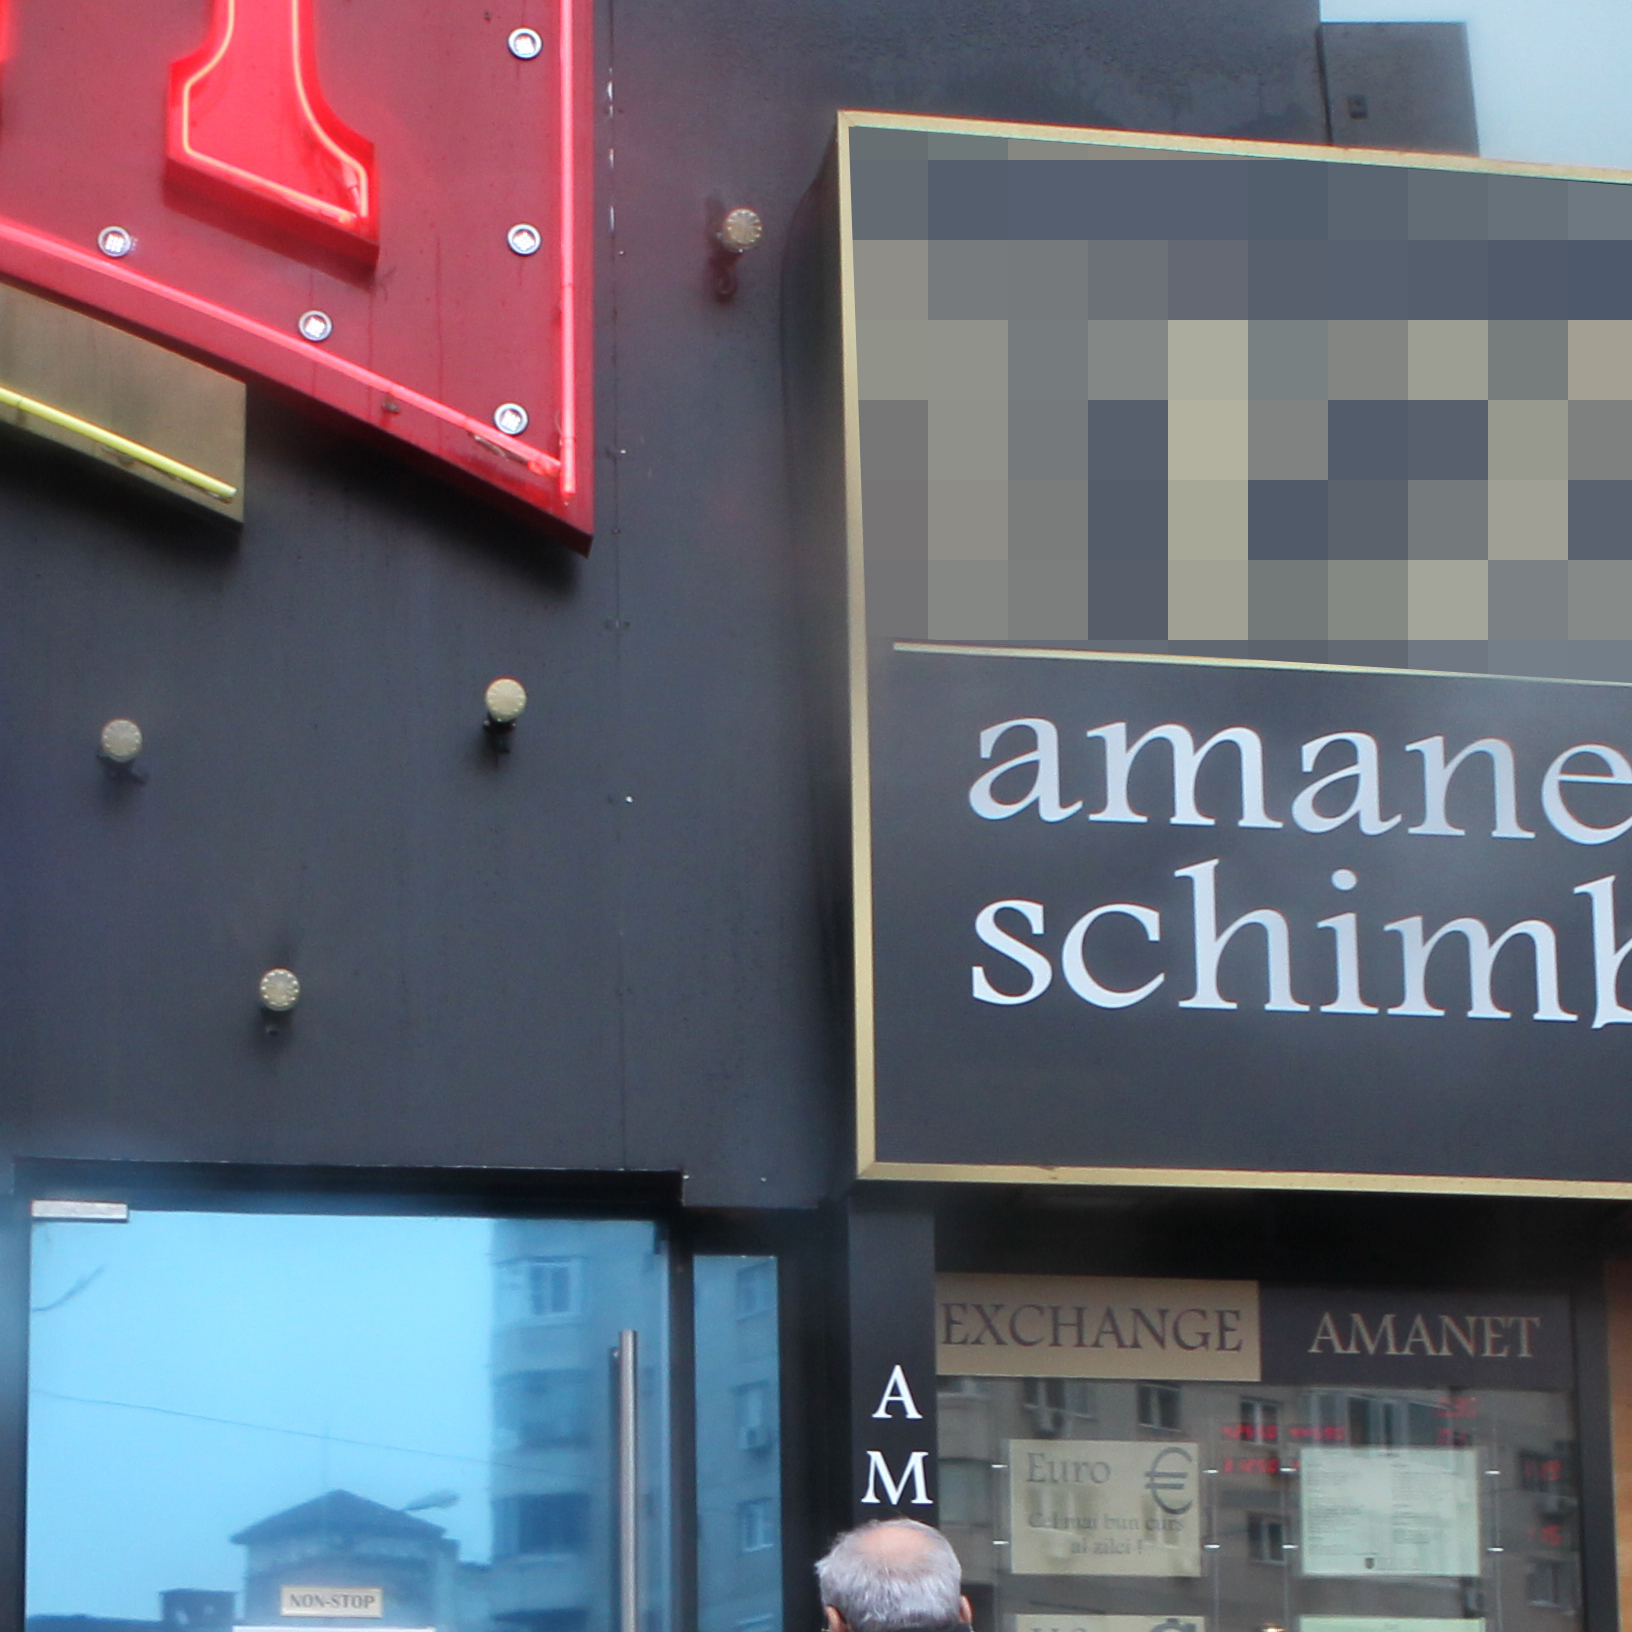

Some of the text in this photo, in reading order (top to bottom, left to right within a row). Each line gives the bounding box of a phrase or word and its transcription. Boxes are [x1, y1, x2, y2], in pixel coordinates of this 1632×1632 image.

[940, 1301, 1243, 1353] EXCHANGE
[1309, 1311, 1540, 1358] AMANET
[1025, 1452, 1111, 1484] Euro
[289, 1594, 376, 1609] NON-STOP
